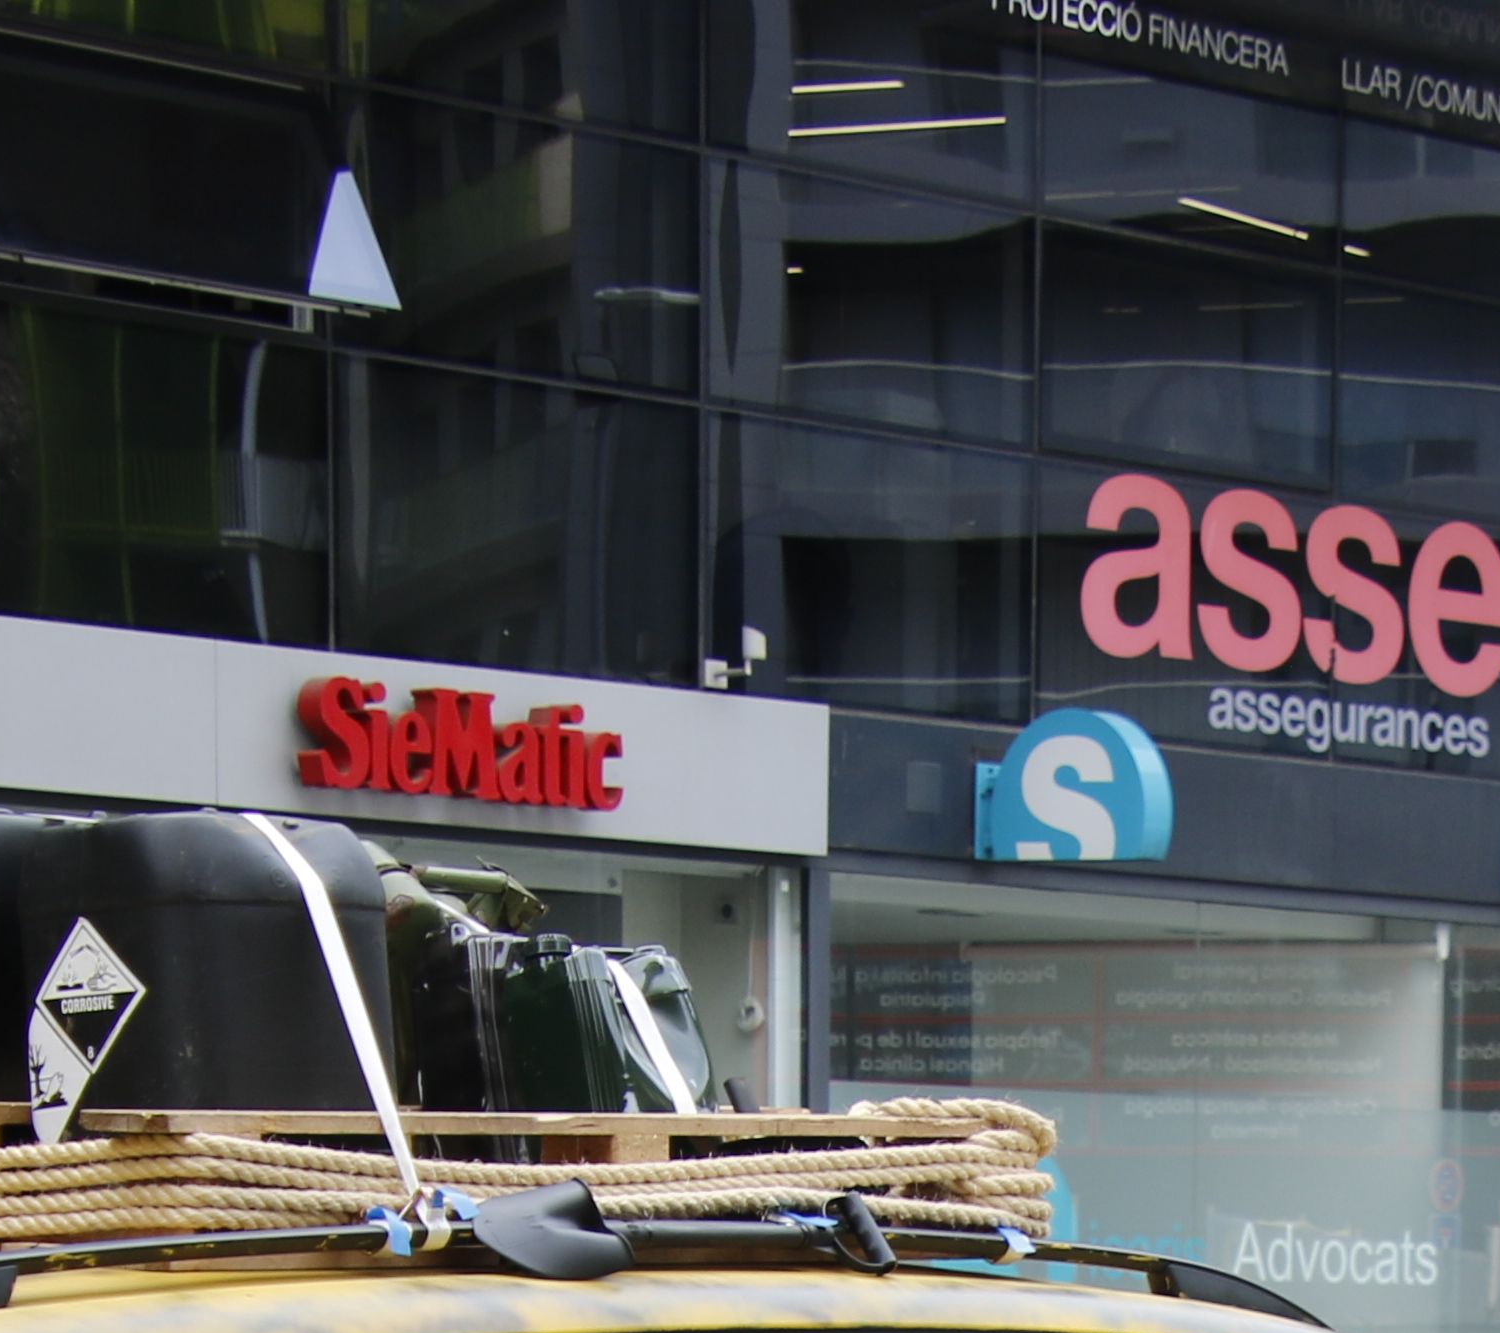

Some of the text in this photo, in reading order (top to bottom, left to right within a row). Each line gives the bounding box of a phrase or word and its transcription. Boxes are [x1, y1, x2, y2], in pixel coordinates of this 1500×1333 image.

[1149, 13, 1290, 77] FINANCERA
[1341, 57, 1401, 102] LLAR
[295, 675, 624, 811] SieMatic
[1208, 686, 1490, 760] assegurances
[60, 994, 116, 1015] CORROSIVE
[86, 1044, 96, 1060] 8
[1232, 1221, 1440, 1286] Advocats
